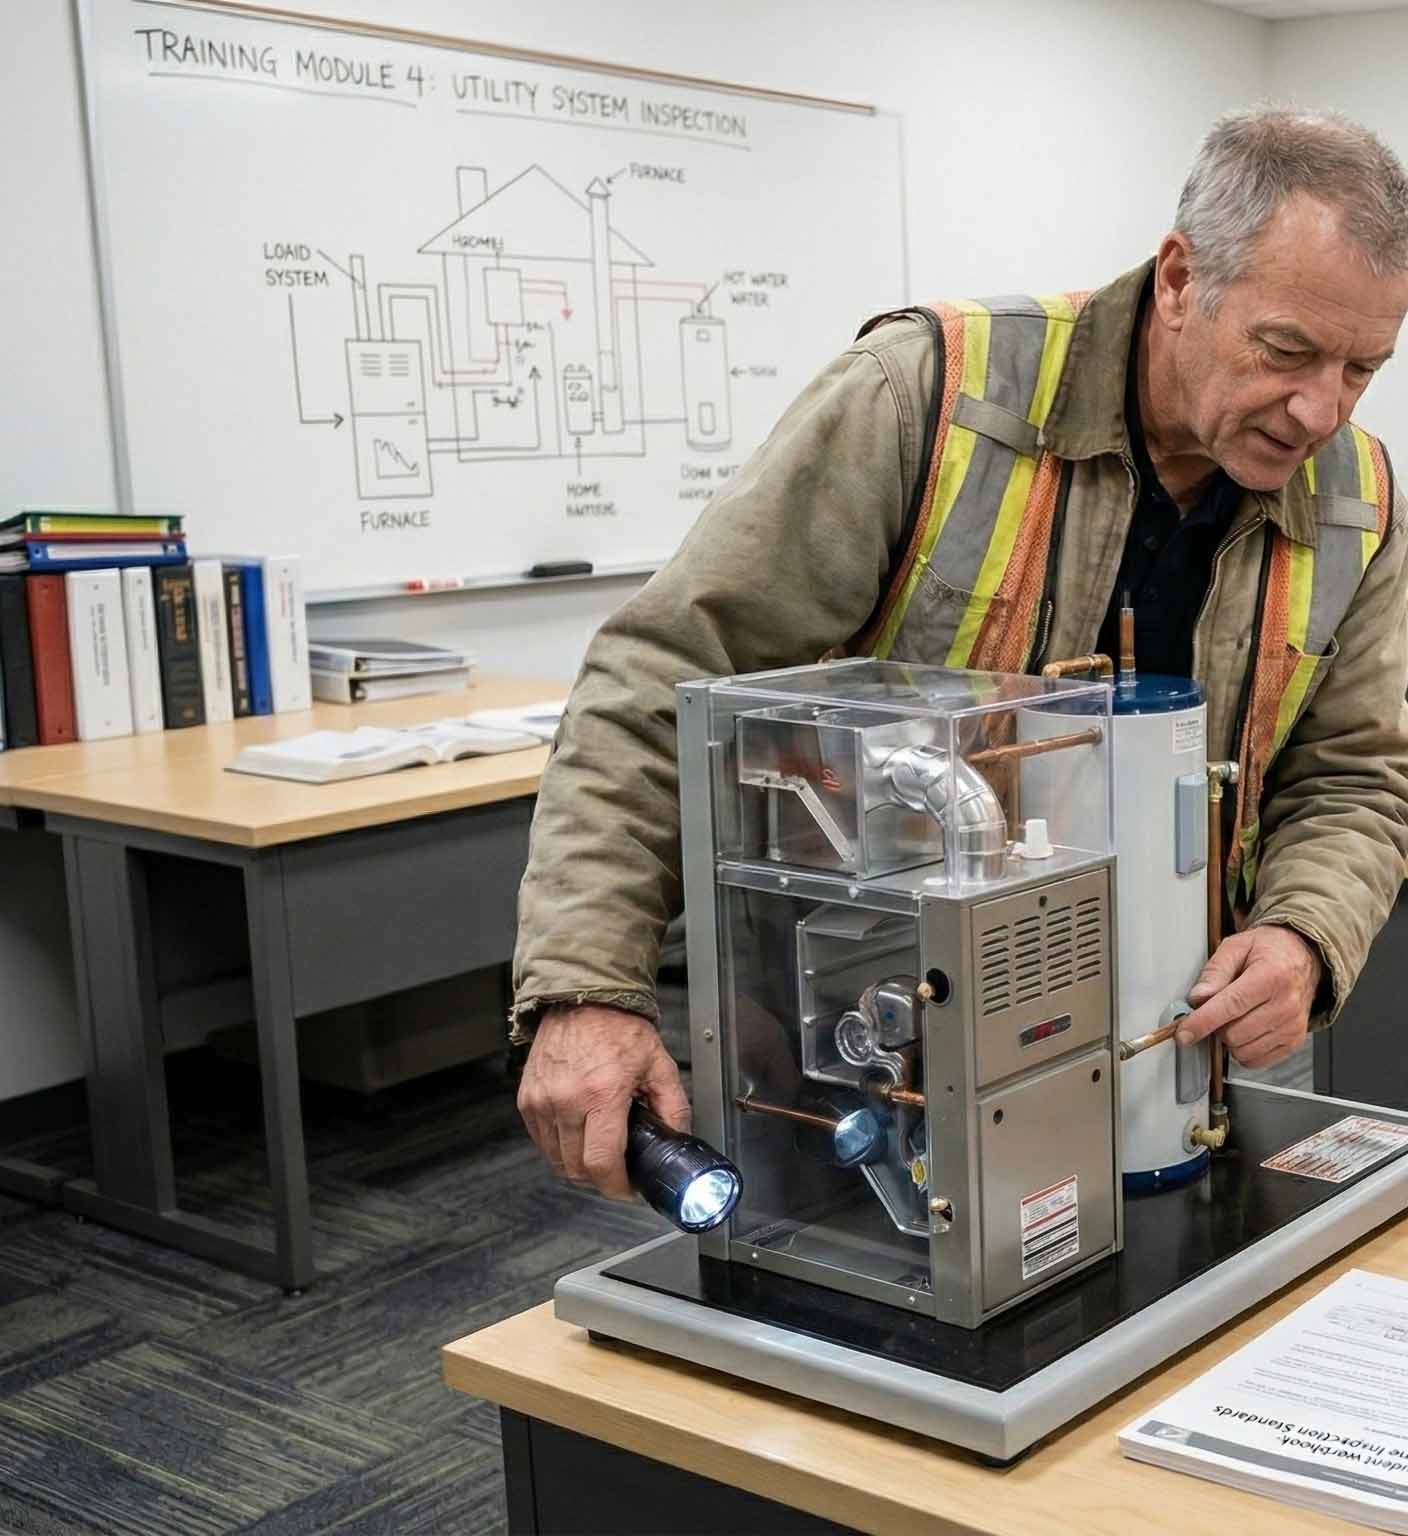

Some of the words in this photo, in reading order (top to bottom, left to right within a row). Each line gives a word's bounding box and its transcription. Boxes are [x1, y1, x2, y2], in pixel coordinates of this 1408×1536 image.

[135, 28, 277, 77] TRAINING
[296, 51, 395, 89] MODULE
[452, 74, 538, 112] UTILITY
[551, 84, 629, 122] SYSTEM
[640, 101, 747, 138] INSPECTION
[265, 268, 329, 287] SYSTEM
[360, 509, 432, 532] FURNACE
[1213, 1404, 1295, 1432] Standards
